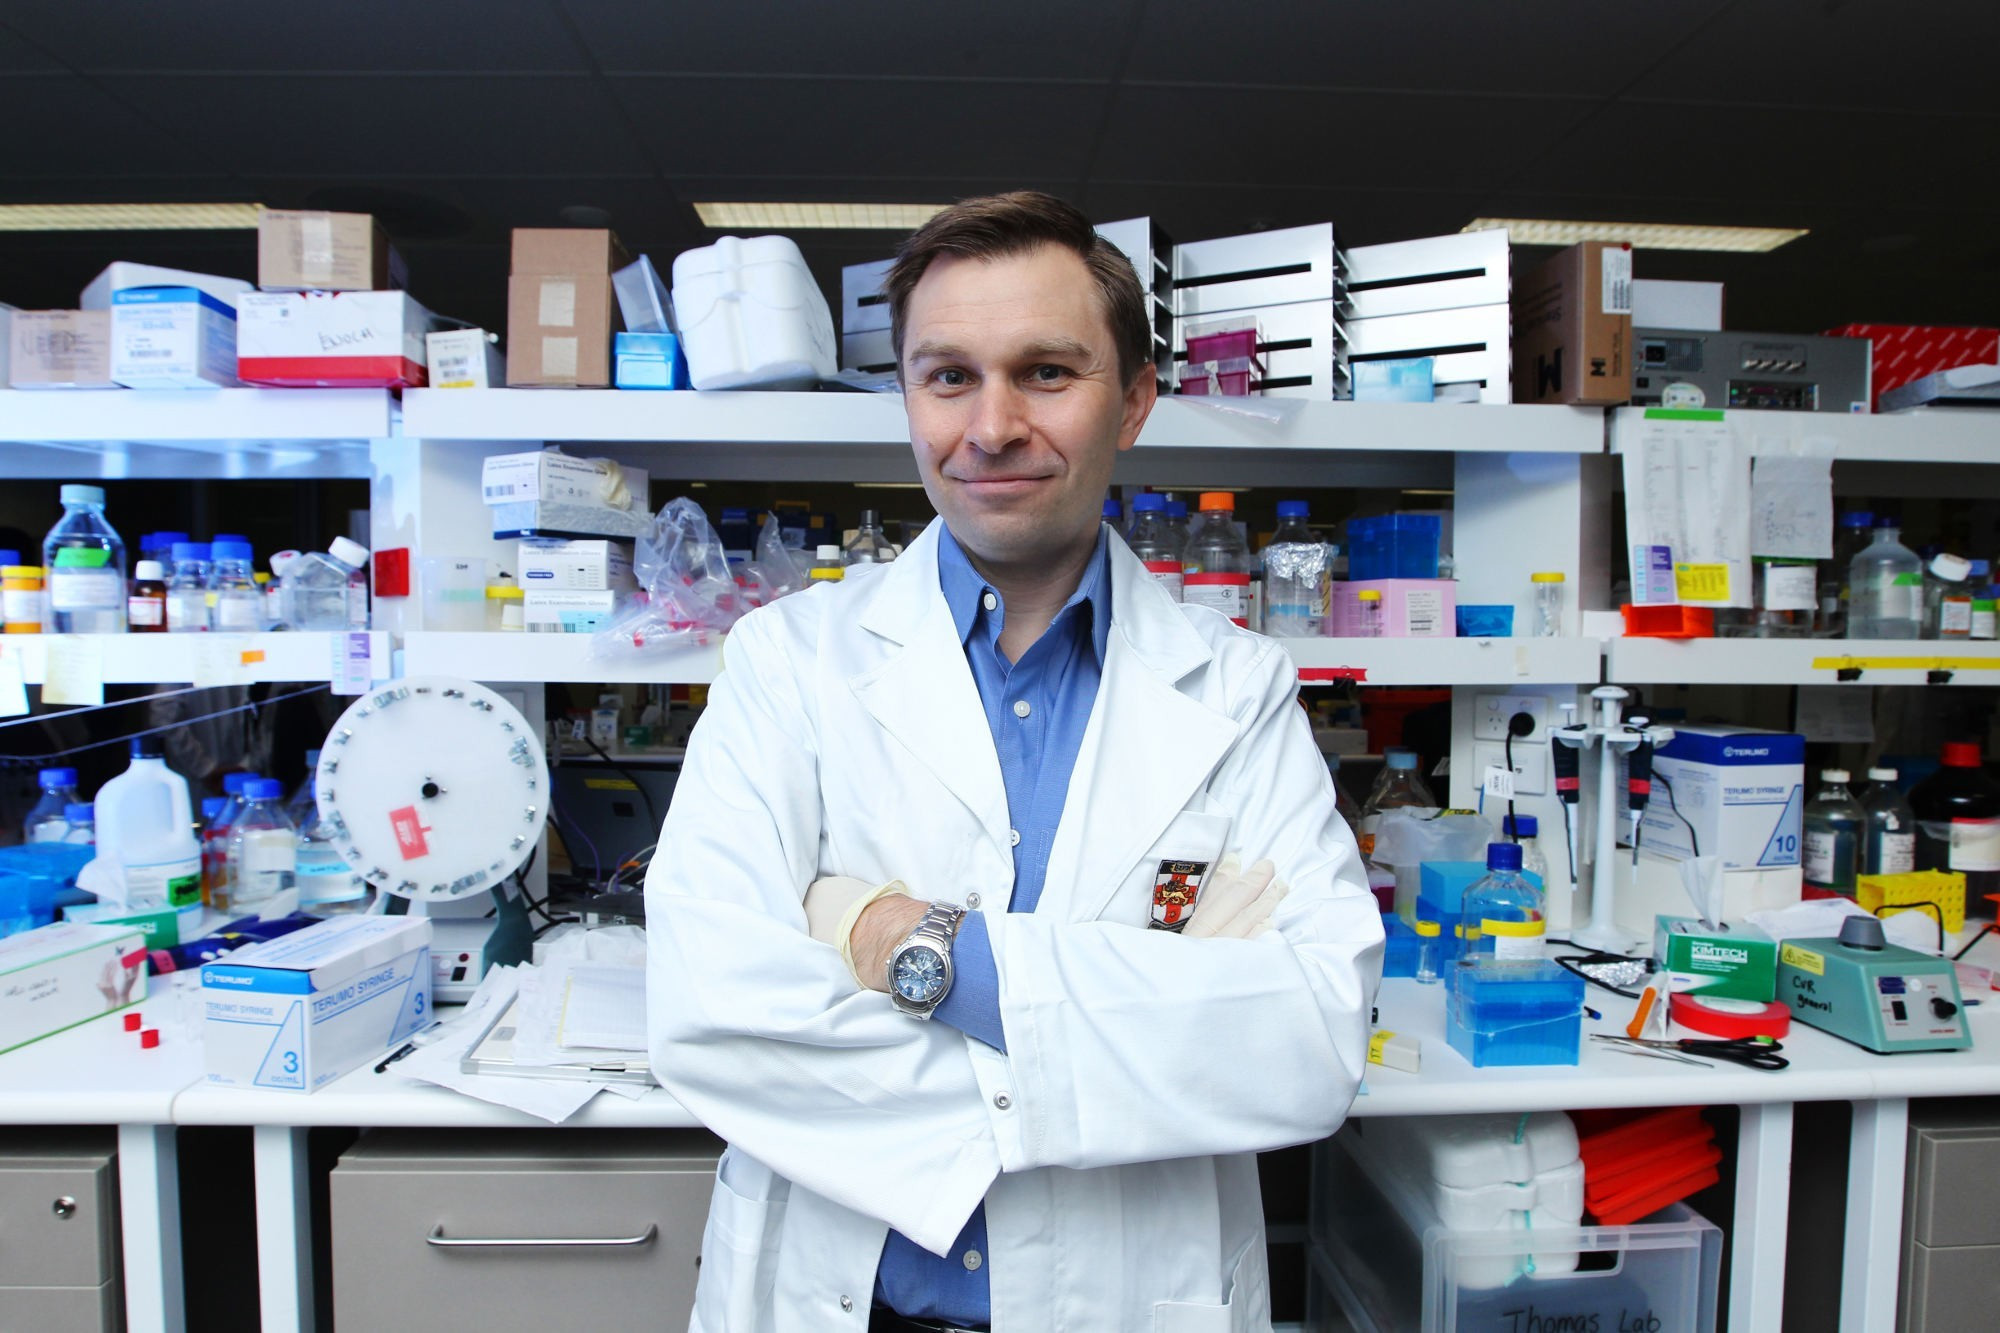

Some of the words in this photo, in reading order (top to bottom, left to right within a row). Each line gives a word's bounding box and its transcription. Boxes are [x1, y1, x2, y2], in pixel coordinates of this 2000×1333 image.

[1733, 748, 1769, 756] TERUMO
[1723, 787, 1754, 795] TERUMO
[1756, 786, 1785, 794] SYRINGE
[1775, 834, 1797, 853] 10
[1692, 946, 1748, 960] KIMTECH
[215, 975, 253, 985] TERUMO
[312, 985, 355, 1013] TERUMO
[357, 967, 395, 994] SYRINGE
[206, 1002, 238, 1012] TERUMO
[240, 1005, 274, 1016] SYRINGE
[414, 991, 425, 1015] 3
[283, 1050, 299, 1074] 3
[1502, 1304, 1601, 1333] Thomas
[1618, 1307, 1662, 1333] Lab
